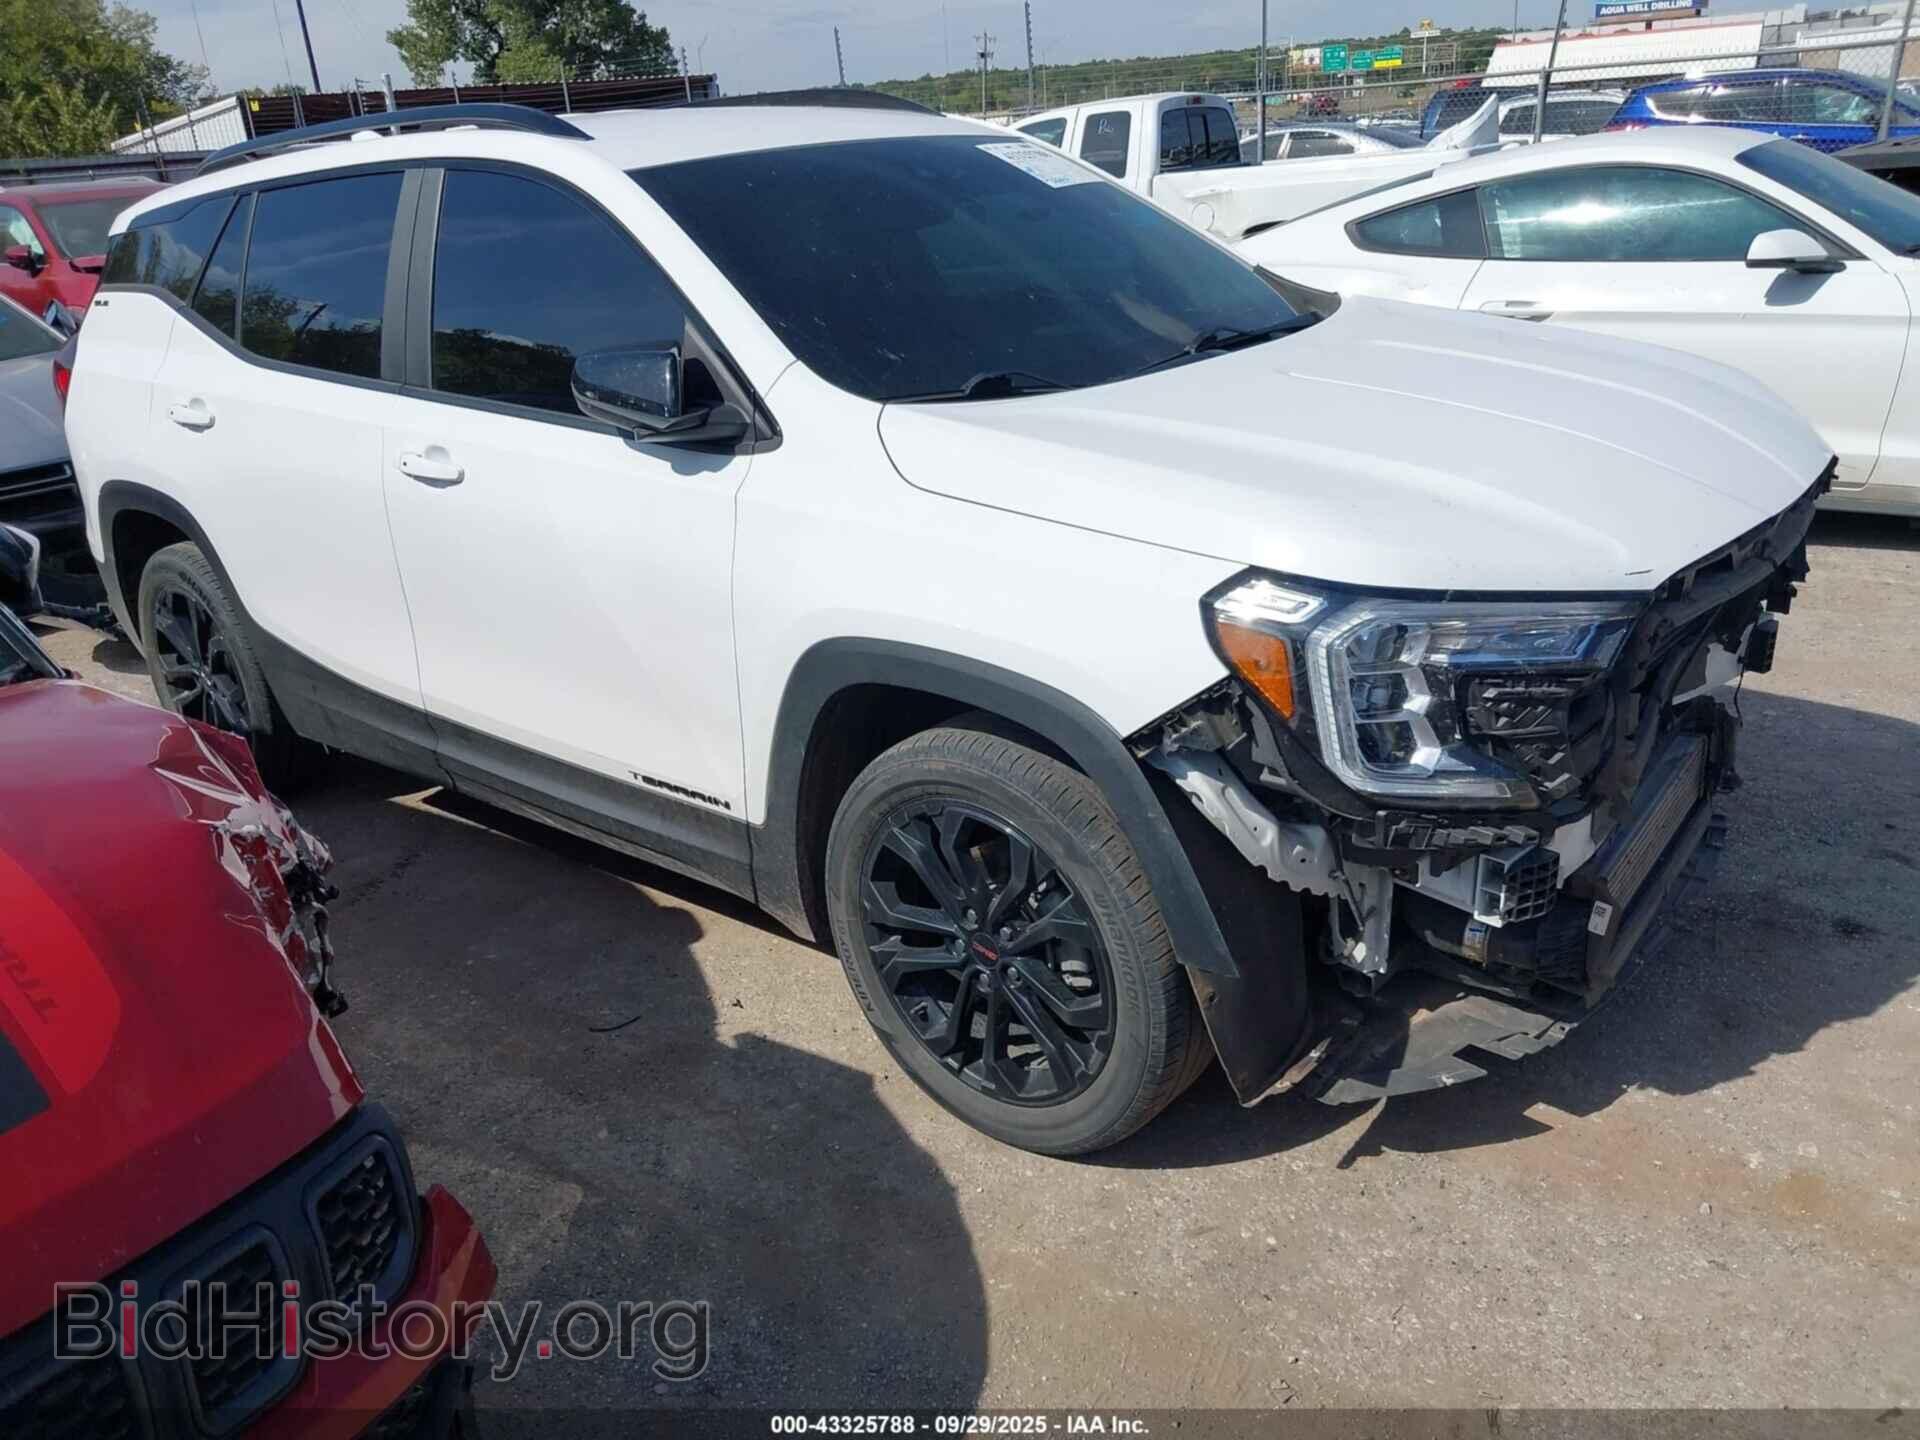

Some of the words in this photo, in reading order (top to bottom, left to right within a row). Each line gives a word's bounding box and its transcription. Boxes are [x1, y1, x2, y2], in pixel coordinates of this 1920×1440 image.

[1600, 5, 1625, 14] AQUA
[1627, 3, 1649, 12] WELL
[1651, 0, 1693, 9] DRILLING
[628, 769, 731, 810] TERRAIN
